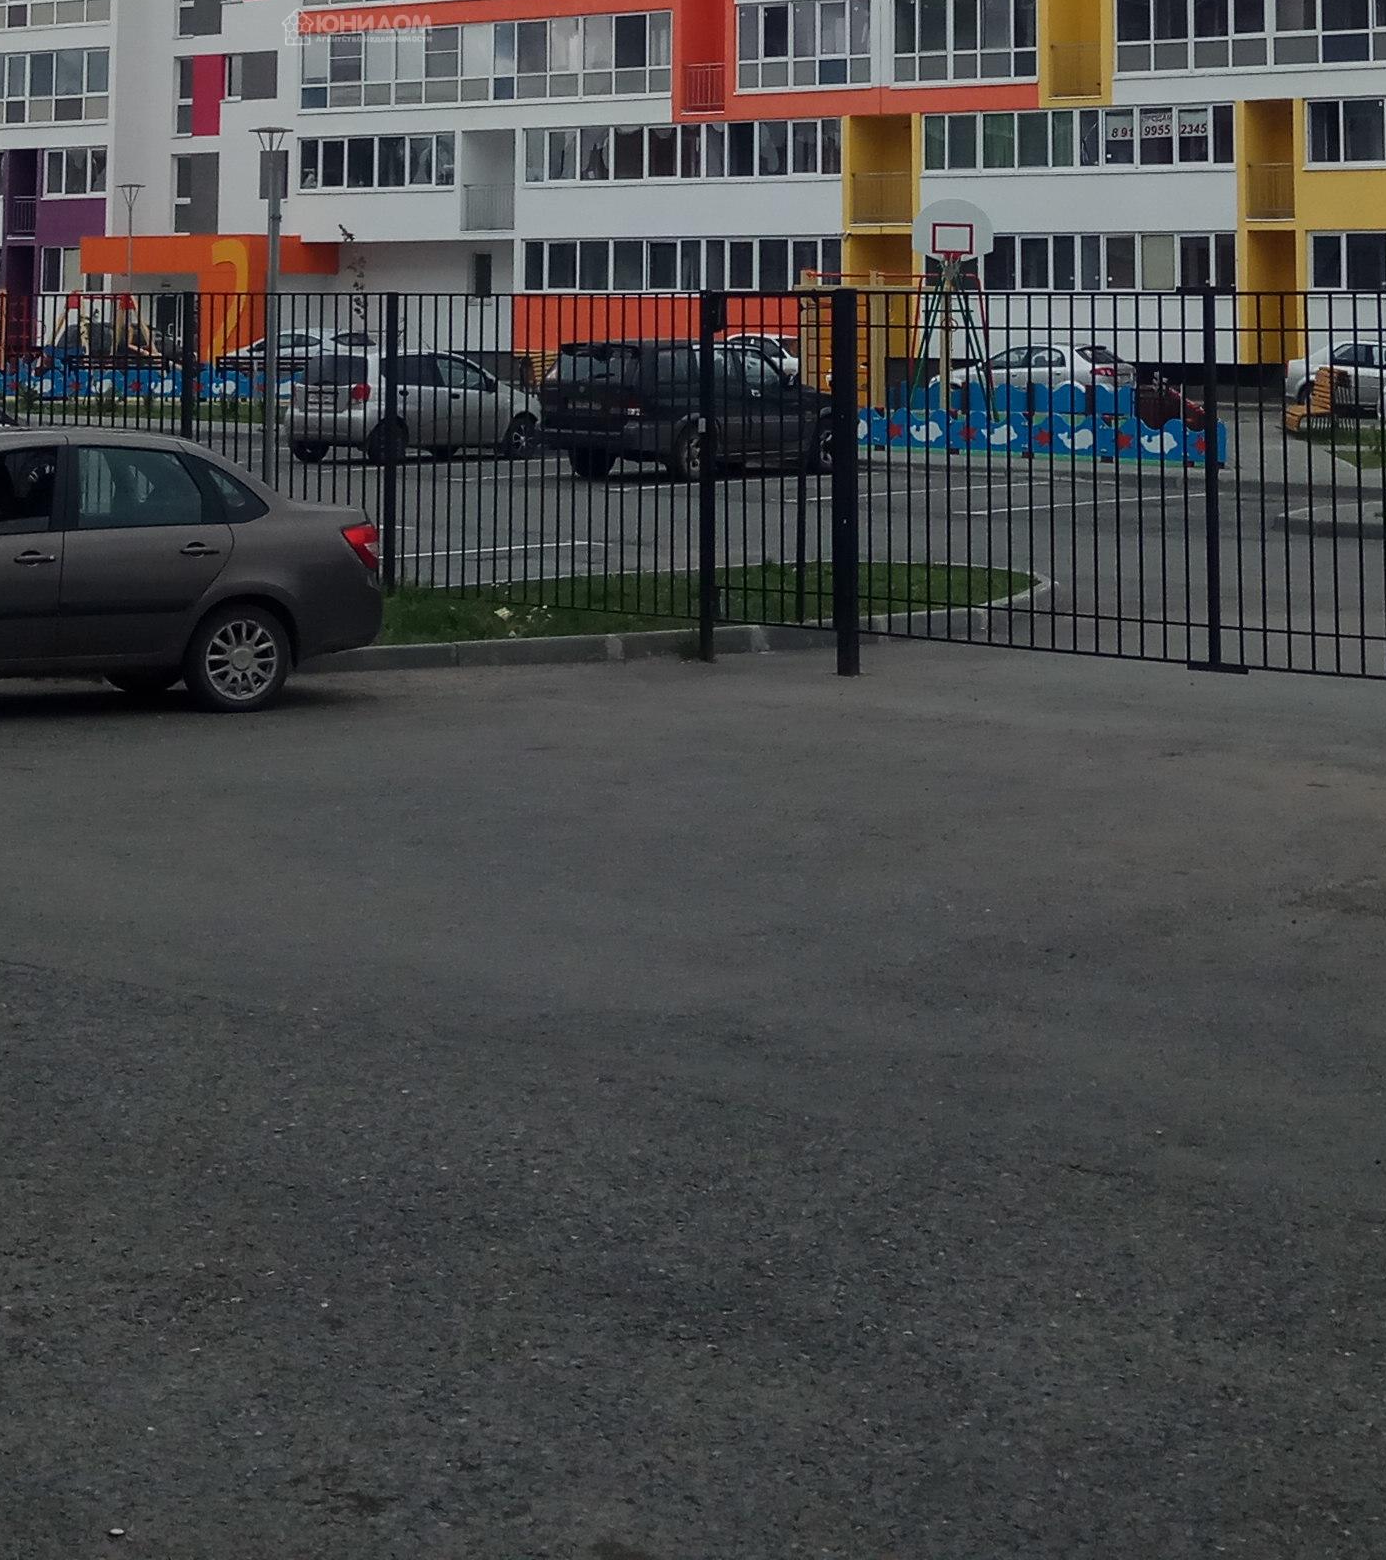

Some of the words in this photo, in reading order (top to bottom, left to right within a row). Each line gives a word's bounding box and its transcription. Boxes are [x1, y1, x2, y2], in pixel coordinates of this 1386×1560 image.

[1111, 127, 1119, 138] 8
[1144, 124, 1171, 136] 9955
[1180, 124, 1207, 135] 2345
